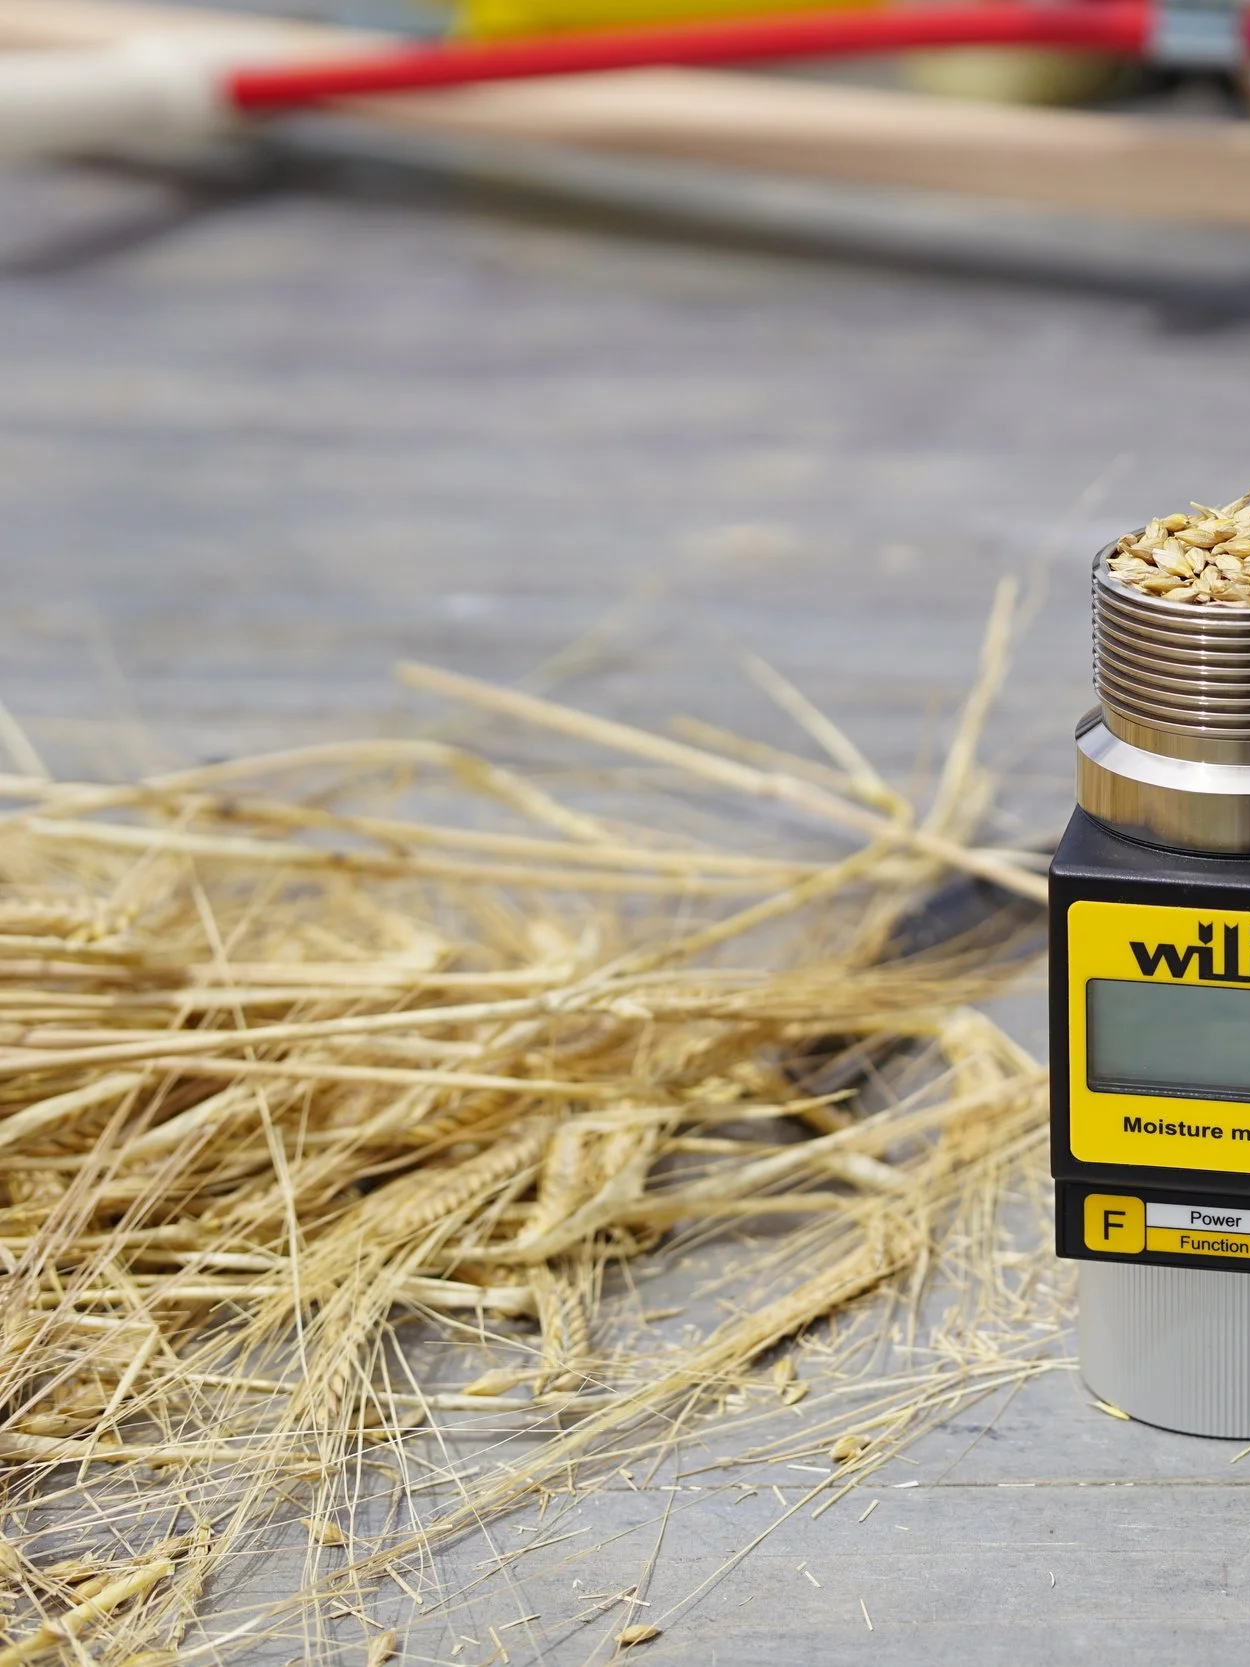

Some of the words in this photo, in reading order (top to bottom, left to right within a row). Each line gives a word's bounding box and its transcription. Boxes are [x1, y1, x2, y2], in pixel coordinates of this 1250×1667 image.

[1123, 1116, 1224, 1140] Moisture
[1103, 1209, 1127, 1241] F
[1190, 1210, 1242, 1228] Power
[1180, 1235, 1249, 1254] Function
